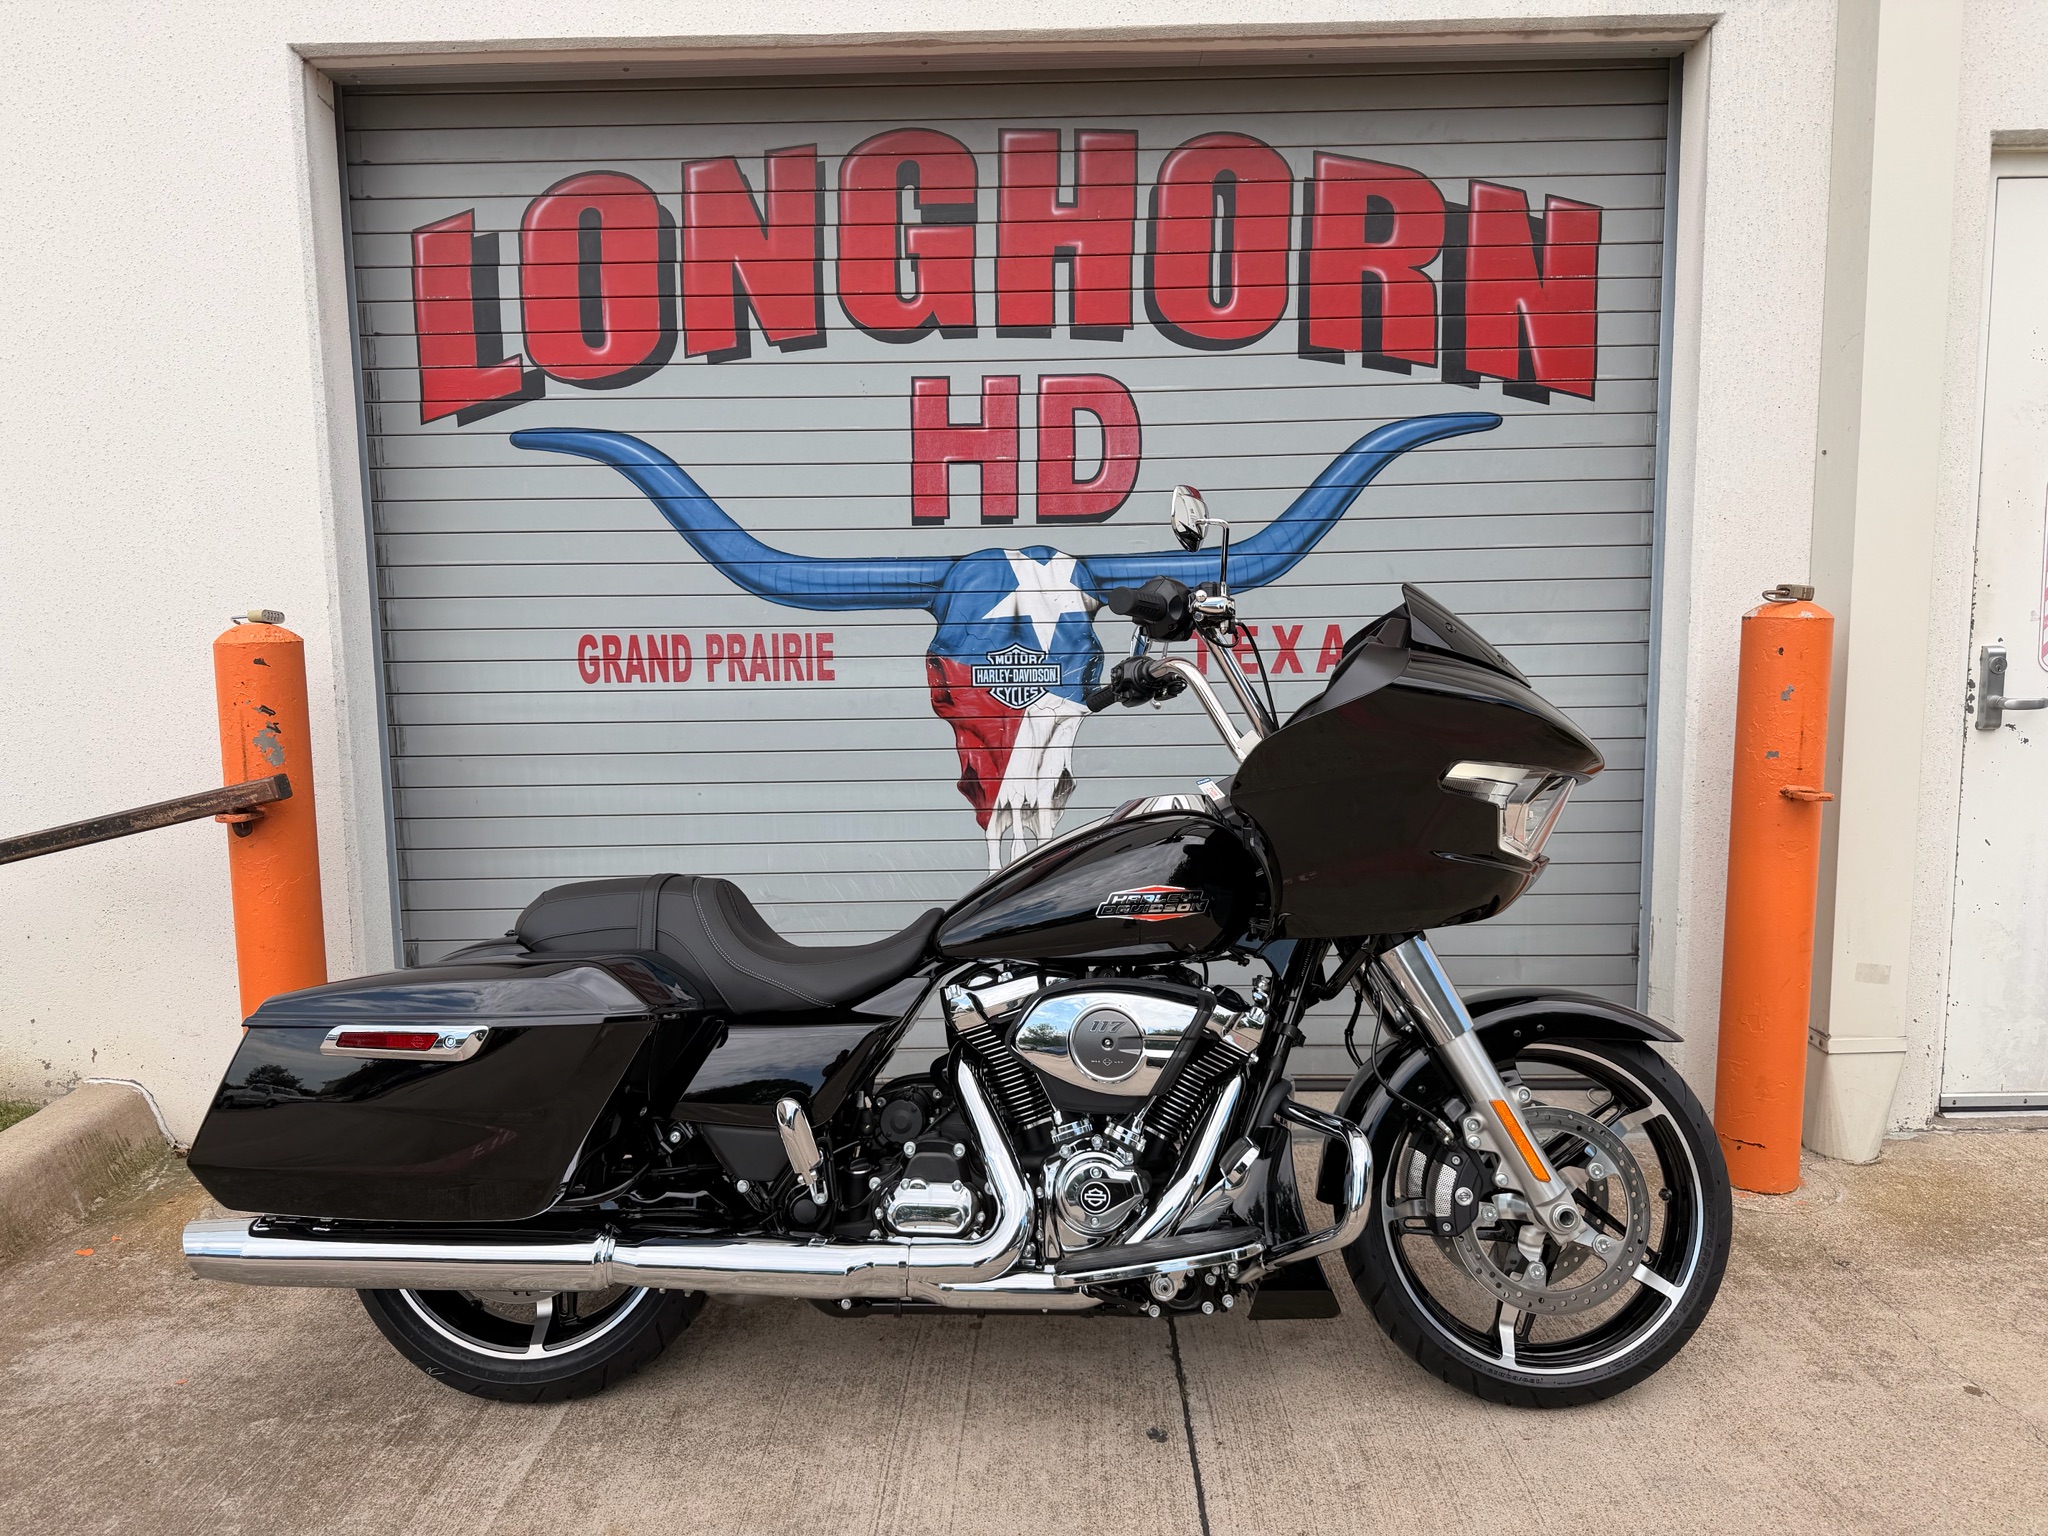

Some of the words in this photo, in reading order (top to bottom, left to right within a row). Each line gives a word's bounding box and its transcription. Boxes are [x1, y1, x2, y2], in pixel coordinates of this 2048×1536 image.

[412, 128, 1603, 425] LONGHORN
[911, 373, 1142, 525] HD
[577, 633, 693, 685] GRAND
[705, 632, 836, 683] PRAIRIE
[1189, 624, 1344, 675] TEXA
[995, 648, 1038, 665] MOTOR
[976, 668, 1057, 684] HARLEY-DAVIDSON
[996, 686, 1039, 706] CYCLES
[1089, 1019, 1128, 1034] 117
